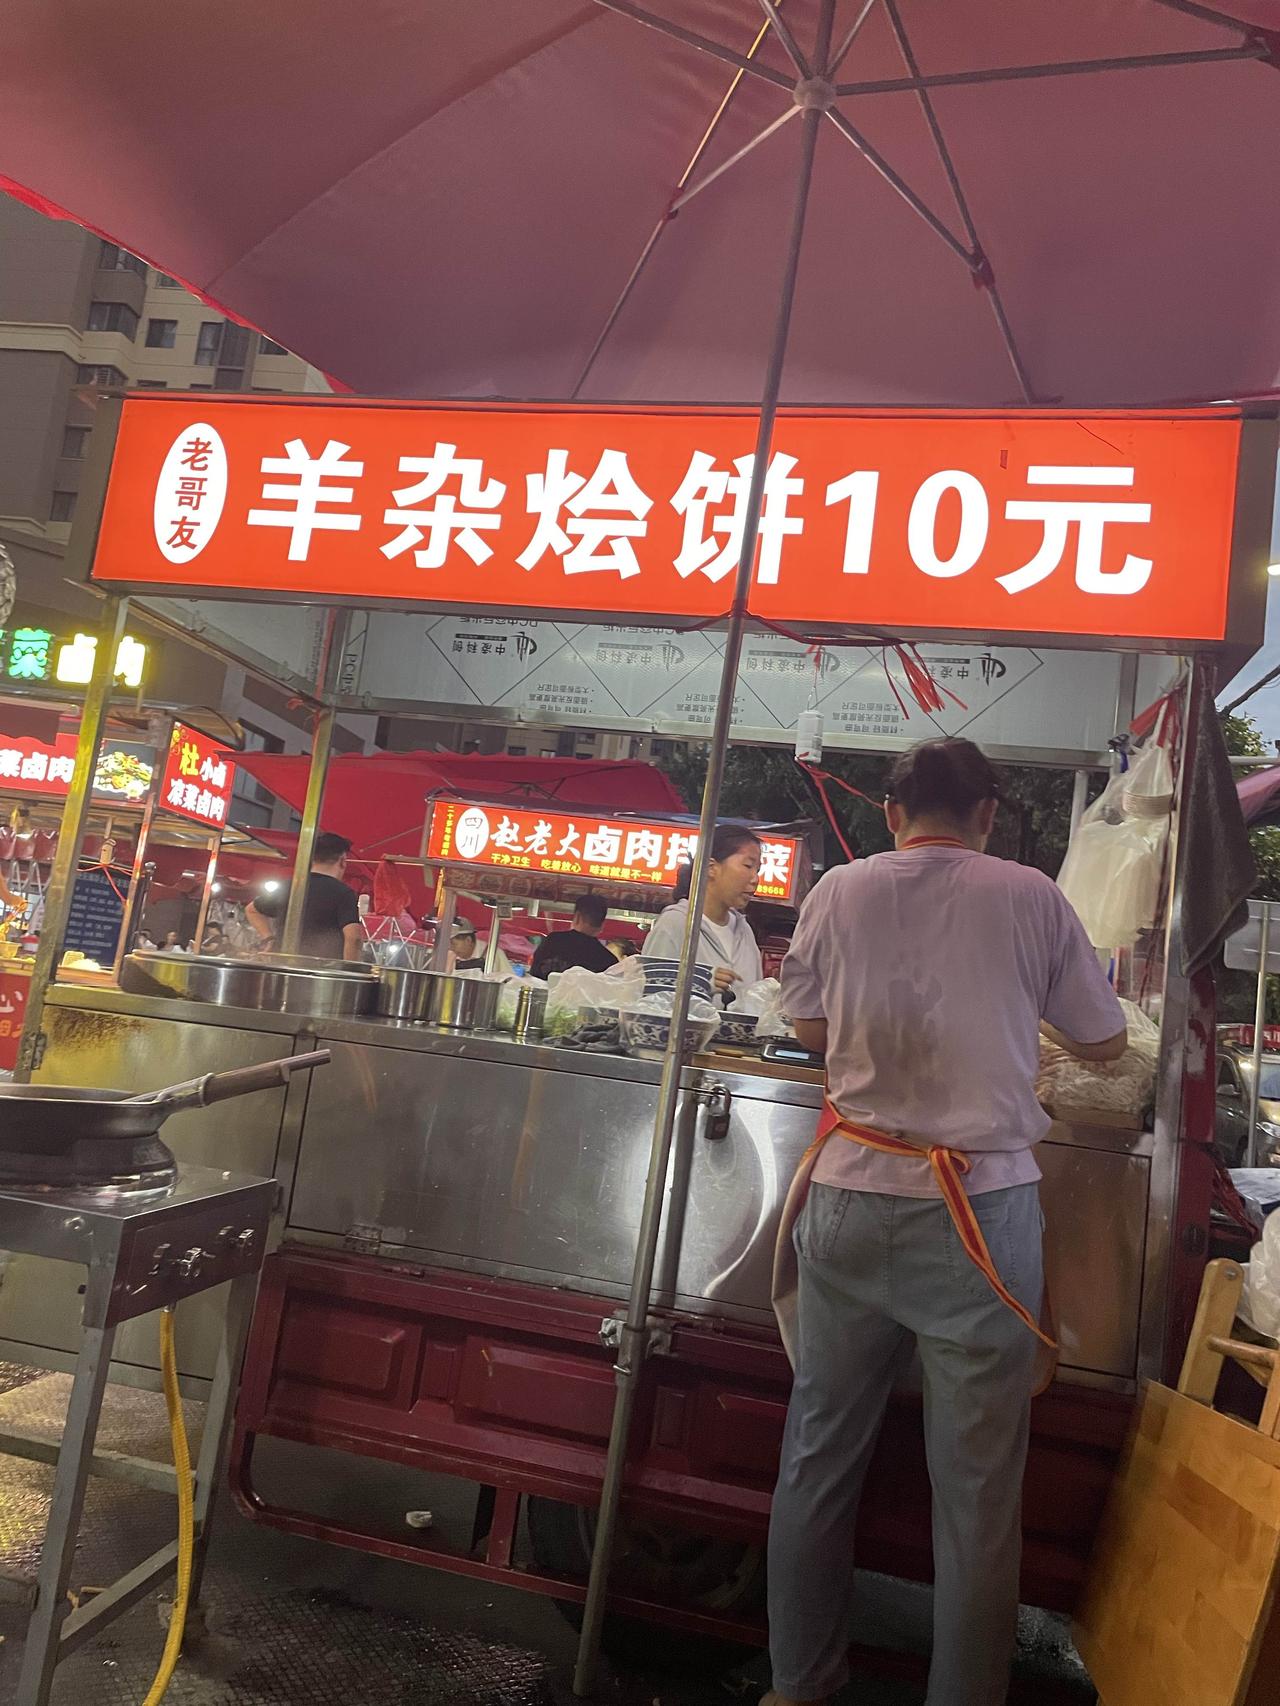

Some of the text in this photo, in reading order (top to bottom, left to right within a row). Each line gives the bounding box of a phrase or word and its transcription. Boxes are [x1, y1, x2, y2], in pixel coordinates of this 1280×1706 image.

[166, 437, 214, 550] 老哥友
[247, 438, 1153, 595] 羊杂烩饼10元
[0, 627, 146, 687] 菜卤肉
[461, 817, 483, 854] 四川
[491, 853, 530, 867] 干净卫生
